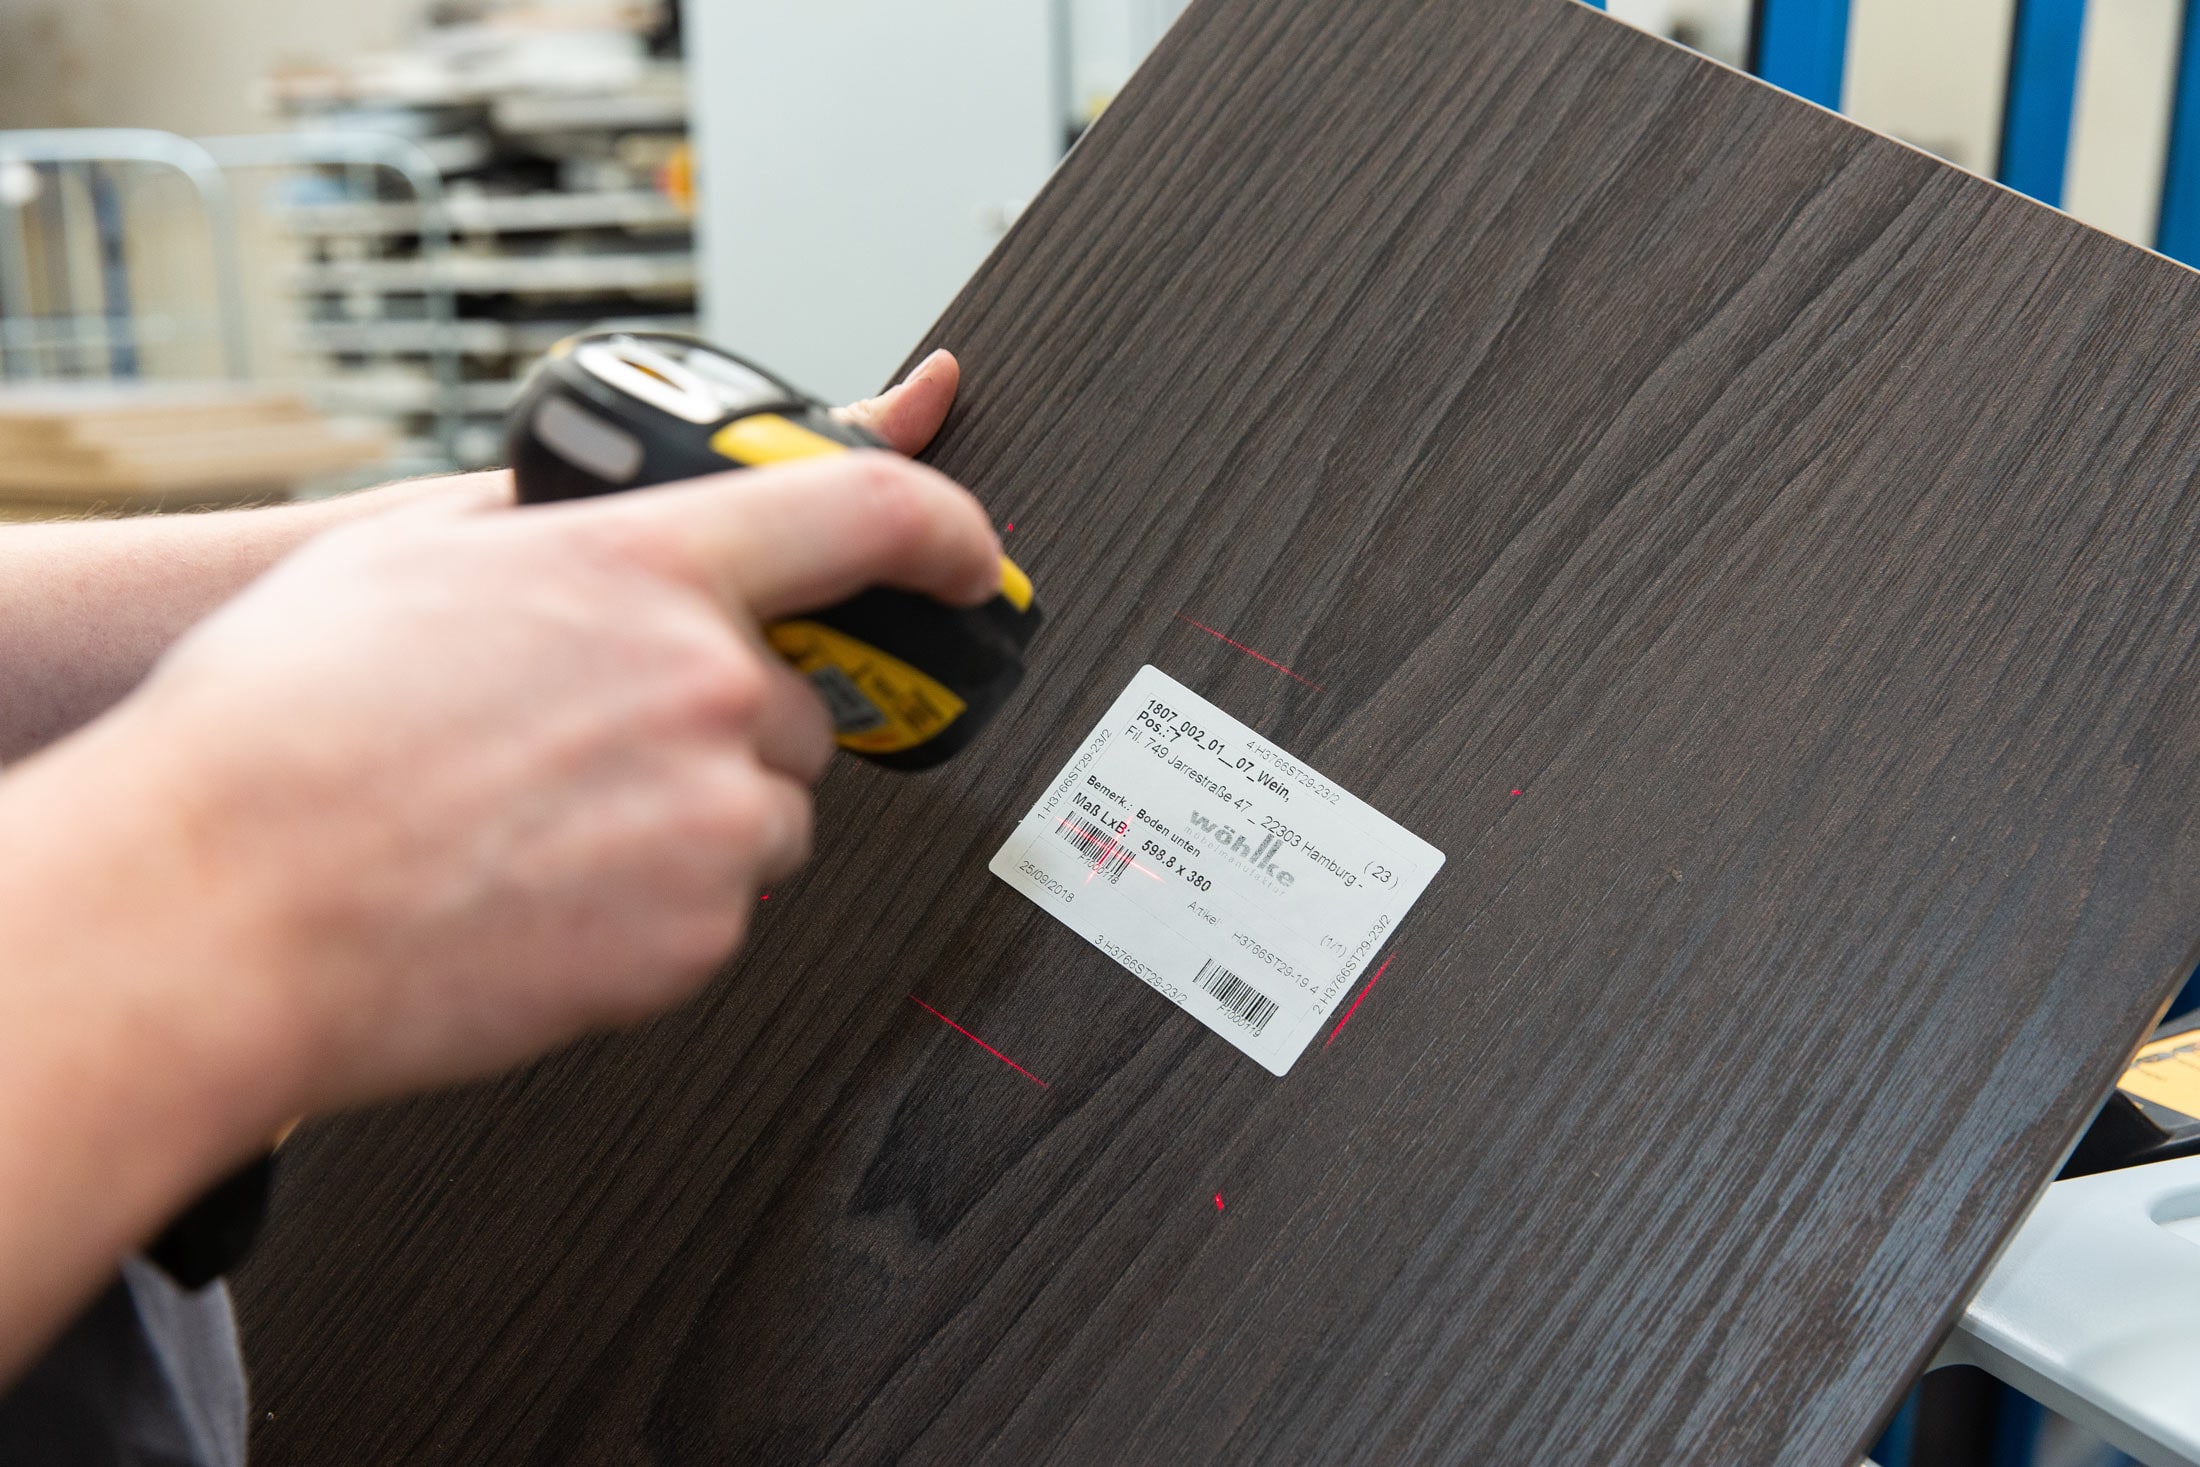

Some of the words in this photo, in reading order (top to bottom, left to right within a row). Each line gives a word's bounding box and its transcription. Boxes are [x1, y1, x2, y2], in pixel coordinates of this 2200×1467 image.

[1136, 710, 1173, 738] Pos.:
[1169, 731, 1182, 743] 7
[1086, 774, 1133, 811] Bemerk.:
[1135, 808, 1170, 837] Boden
[1170, 833, 1201, 858] unten
[1124, 724, 1143, 744] Fil.
[1144, 736, 1169, 759] 749
[1167, 754, 1233, 803] Jarrestraße
[1233, 798, 1253, 813] 47
[1260, 815, 1303, 847] 22303
[1300, 841, 1358, 887] Hamburg
[1072, 791, 1101, 817] Maß
[1099, 810, 1131, 838] LxB:
[1141, 839, 1177, 868] 598.8
[1174, 864, 1187, 877] x
[1186, 870, 1212, 892] 380
[1077, 853, 1120, 885] F1000118
[1190, 809, 1295, 888] wöhlke
[1018, 860, 1075, 903] 25/09/2018
[1216, 1003, 1262, 1038] F1000119
